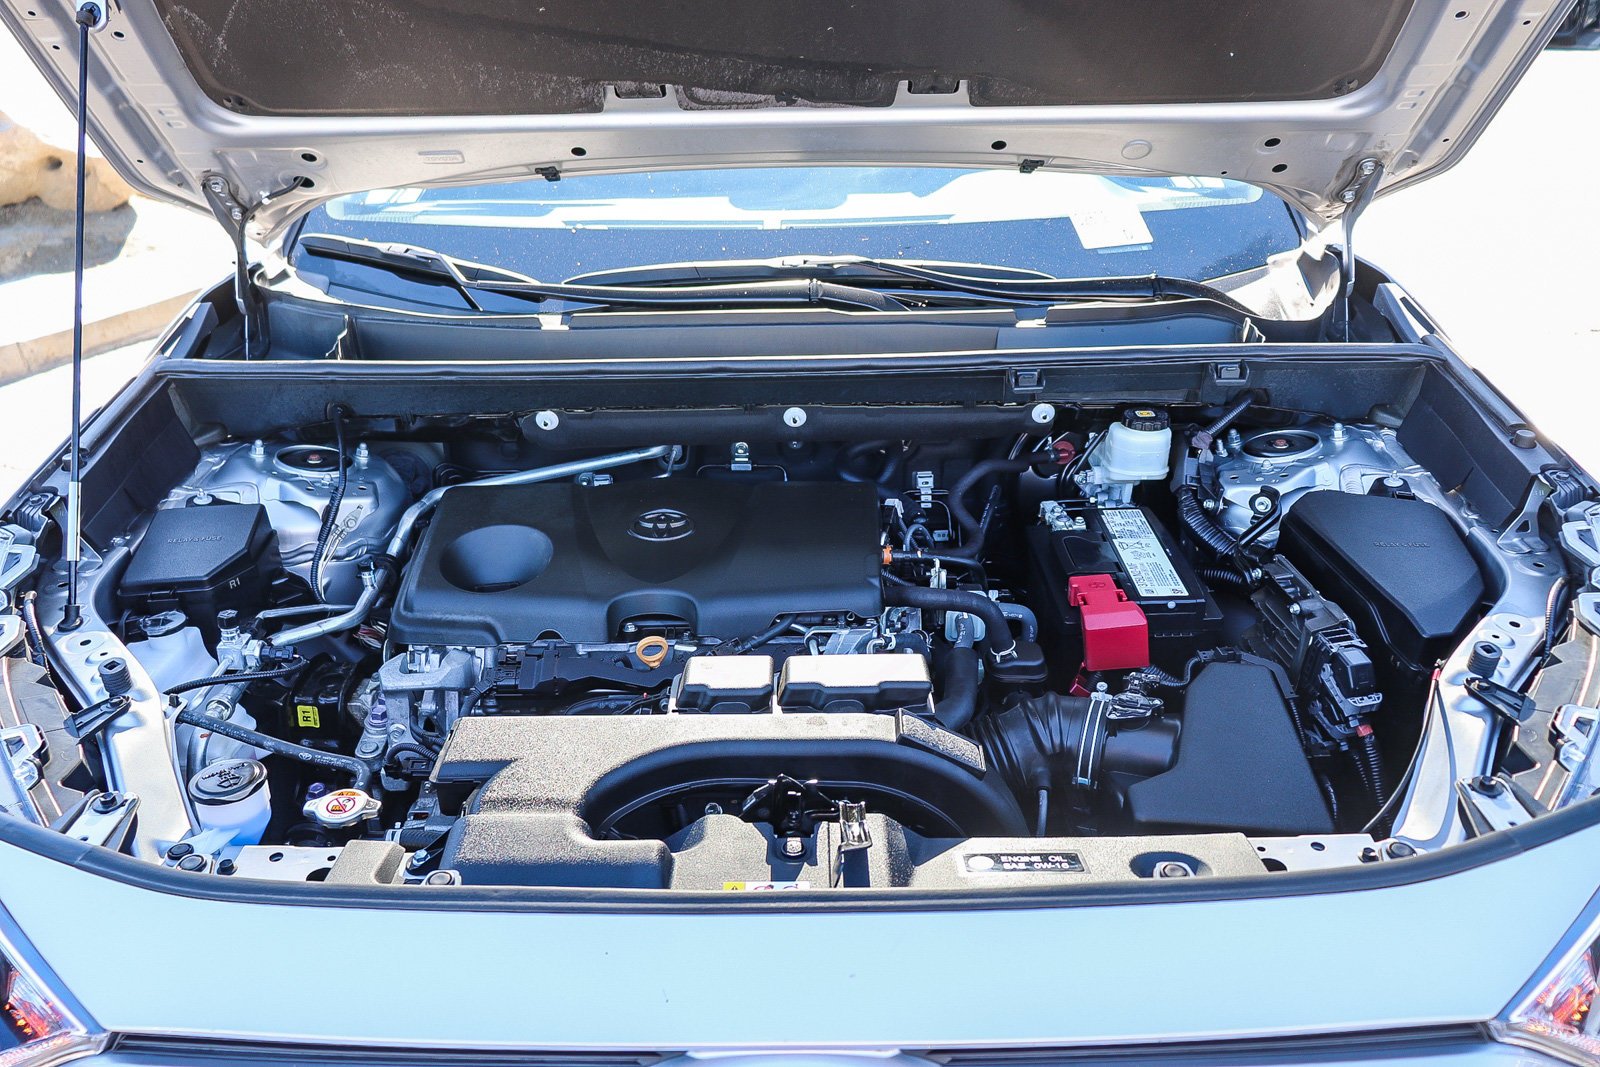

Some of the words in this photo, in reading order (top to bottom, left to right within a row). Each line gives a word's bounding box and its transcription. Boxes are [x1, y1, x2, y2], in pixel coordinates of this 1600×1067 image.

[229, 577, 241, 590] R1
[301, 710, 312, 722] R1
[1003, 862, 1026, 870] SAE
